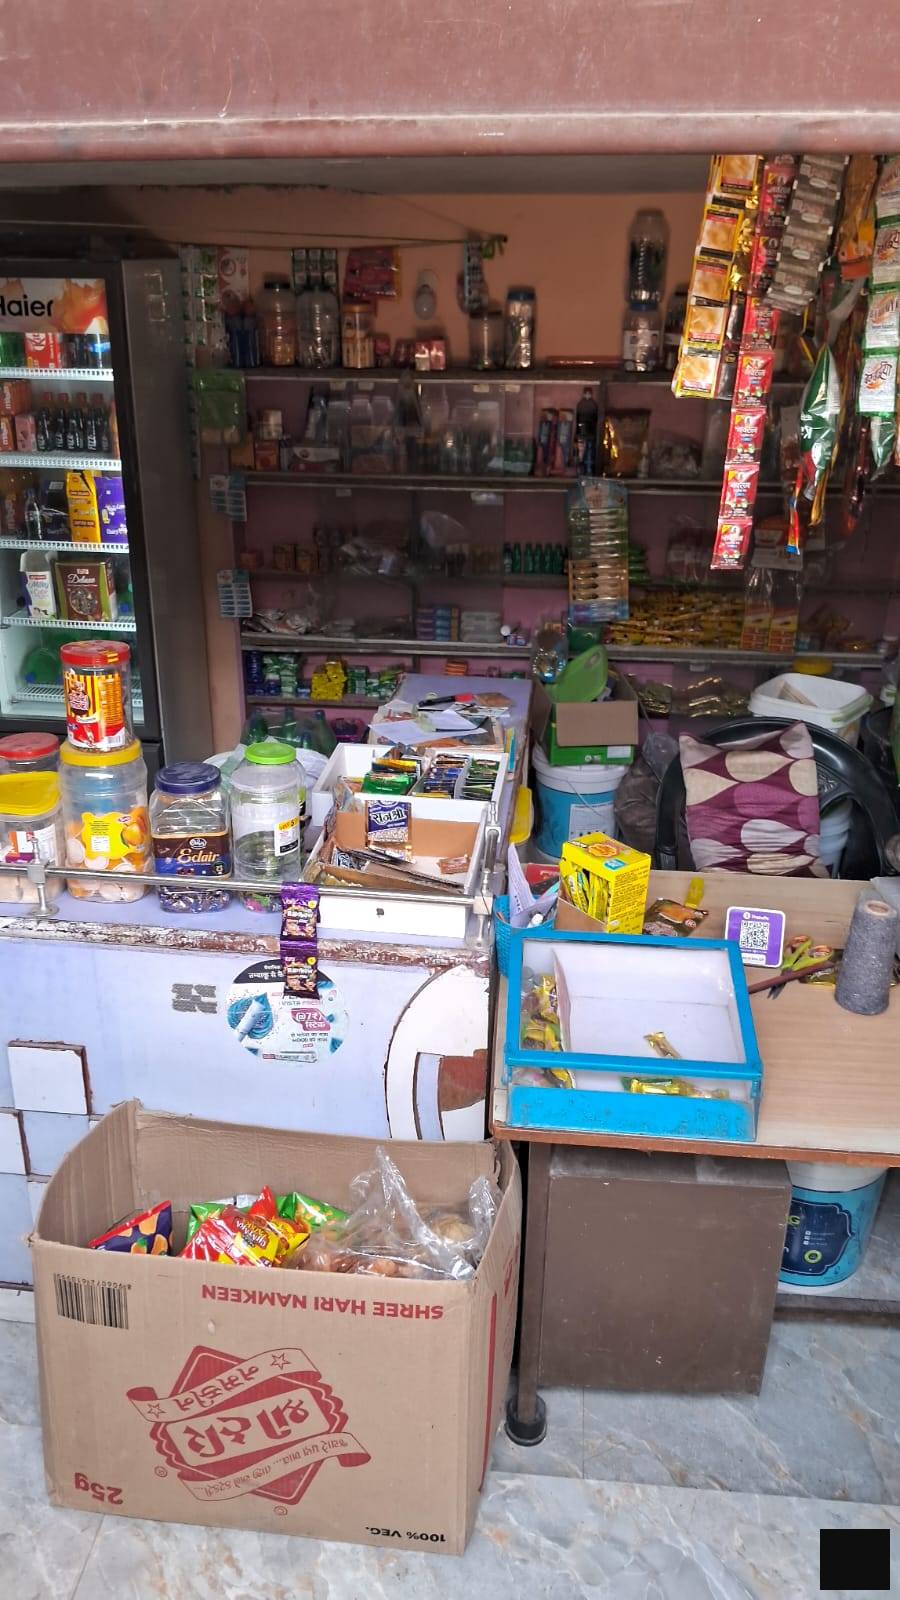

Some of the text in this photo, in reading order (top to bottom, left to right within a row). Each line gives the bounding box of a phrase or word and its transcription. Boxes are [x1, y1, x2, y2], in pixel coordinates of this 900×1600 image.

[177, 848, 220, 864] Eclair
[201, 1284, 444, 1320] SHREE HARI NAMKEEN
[173, 1366, 259, 1411] નમકીન
[256, 1399, 309, 1440] શ્રી
[74, 1472, 124, 1505] 25g
[406, 1531, 446, 1542] 100%
